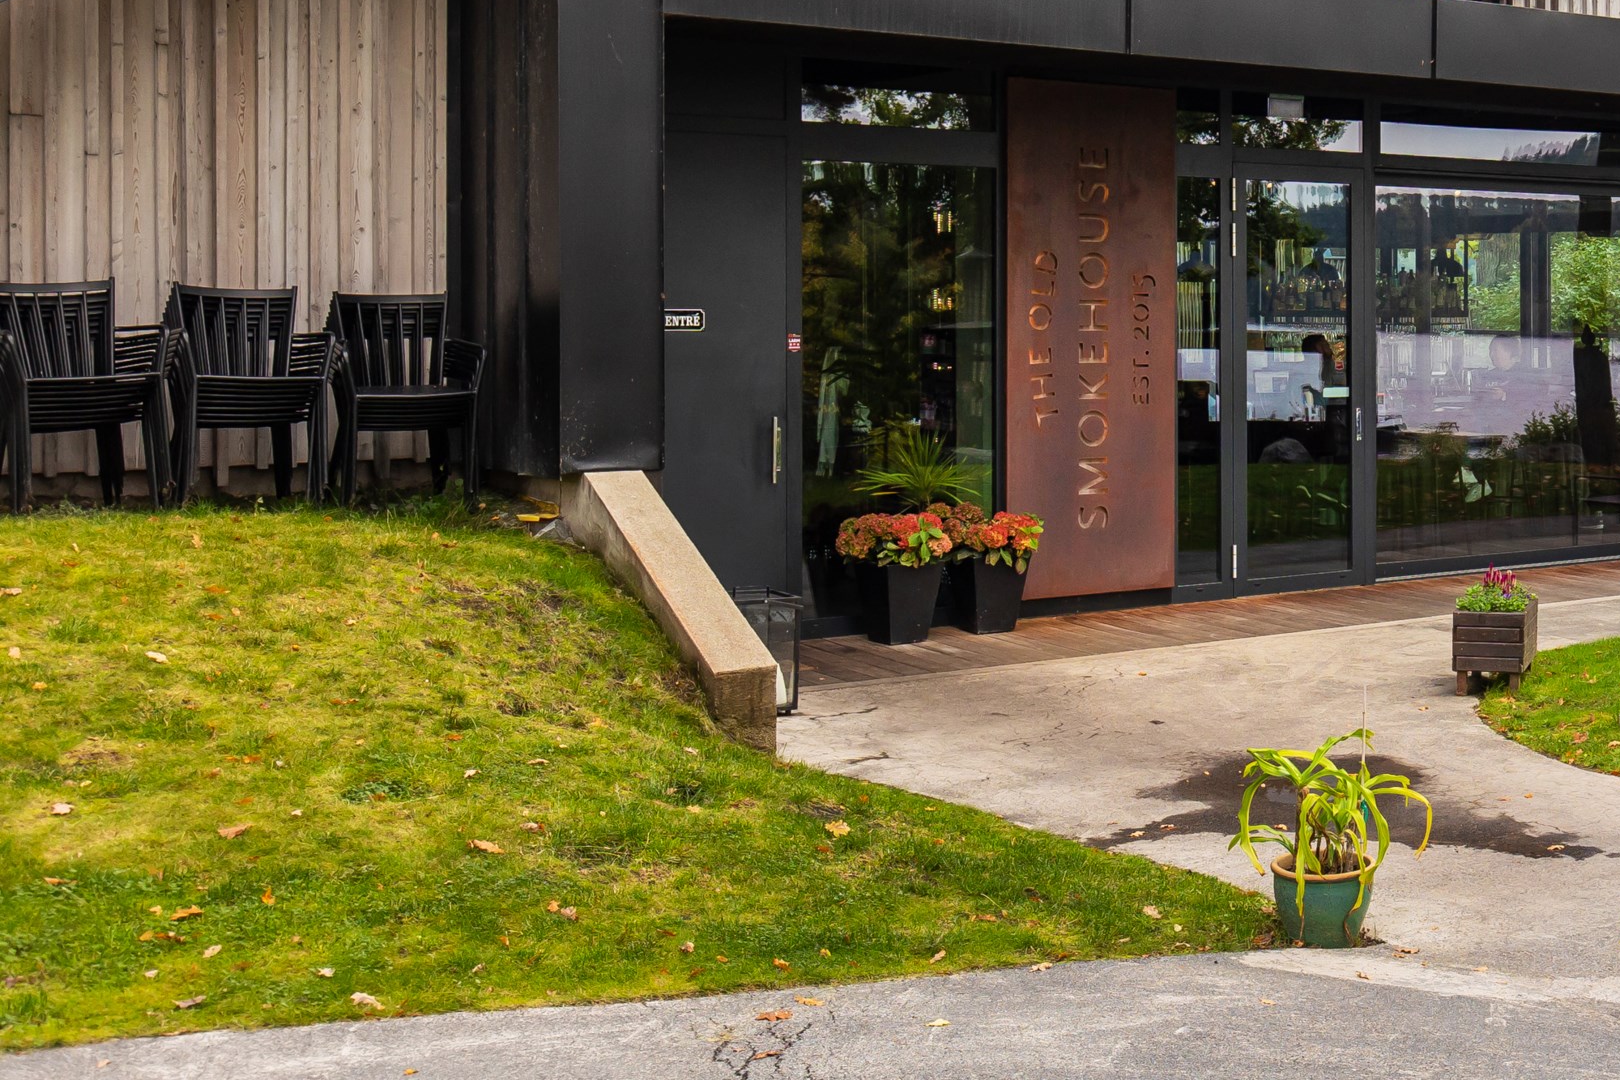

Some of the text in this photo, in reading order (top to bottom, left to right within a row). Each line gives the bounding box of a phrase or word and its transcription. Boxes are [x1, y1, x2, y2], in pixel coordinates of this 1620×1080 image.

[664, 313, 701, 327] ENTRÉ
[1029, 251, 1060, 429] THE OLD
[1078, 146, 1110, 529] SMOKEHOUSE
[1132, 273, 1156, 406] EST. 2015
